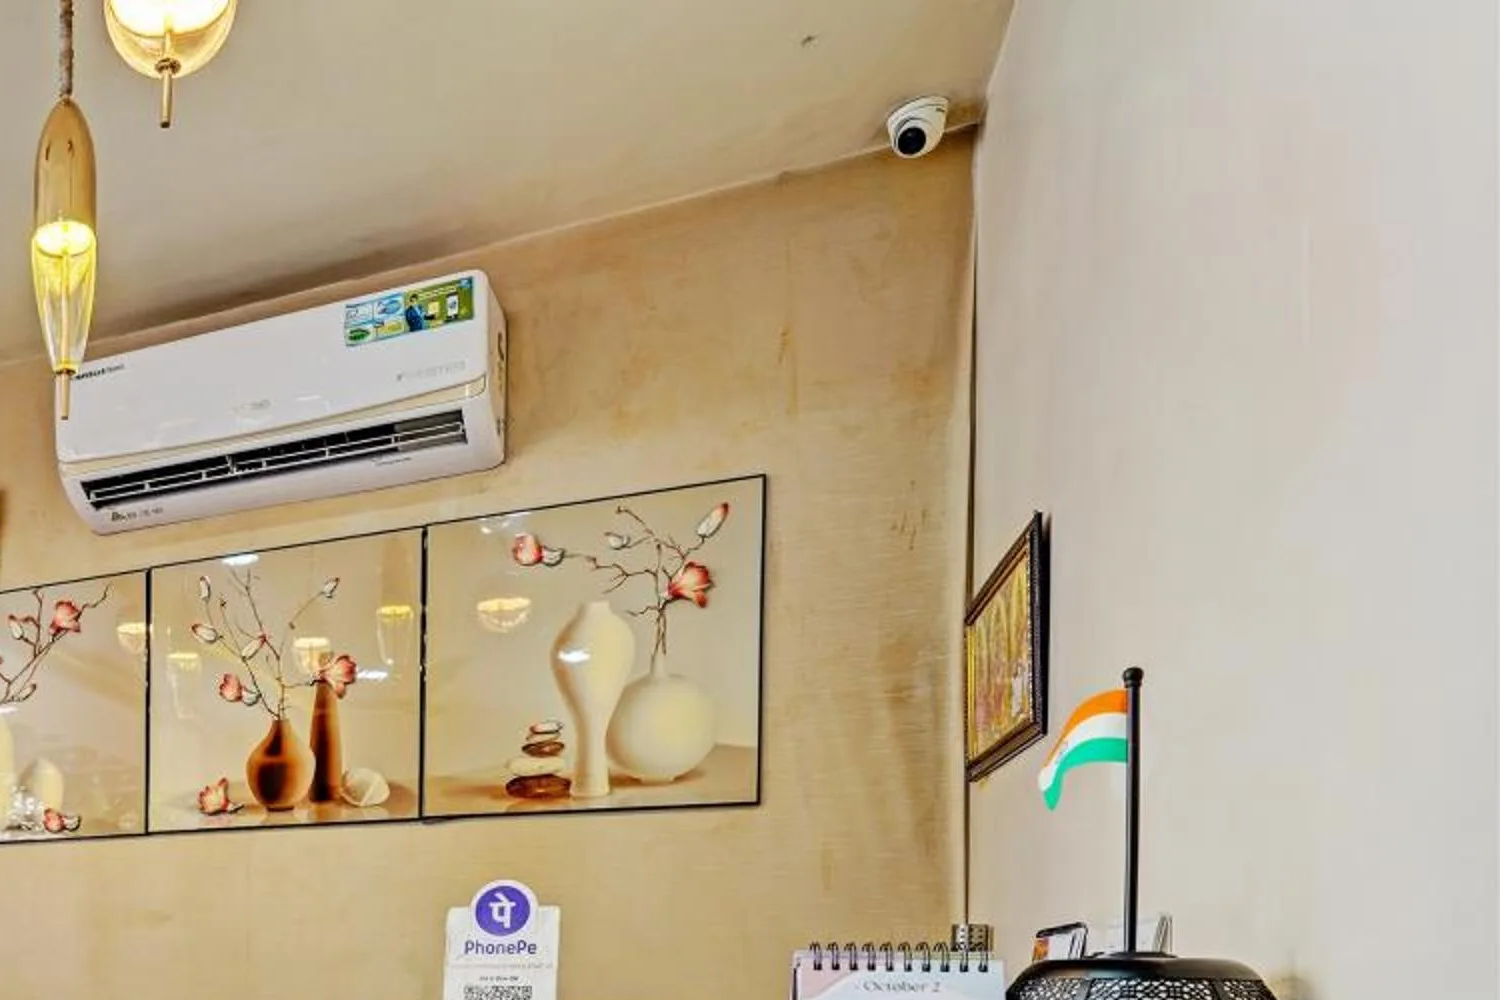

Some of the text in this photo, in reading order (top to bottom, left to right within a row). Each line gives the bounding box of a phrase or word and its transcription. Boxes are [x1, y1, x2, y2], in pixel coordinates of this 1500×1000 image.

[464, 939, 537, 955] PhonePe
[863, 980, 941, 993] October 2
